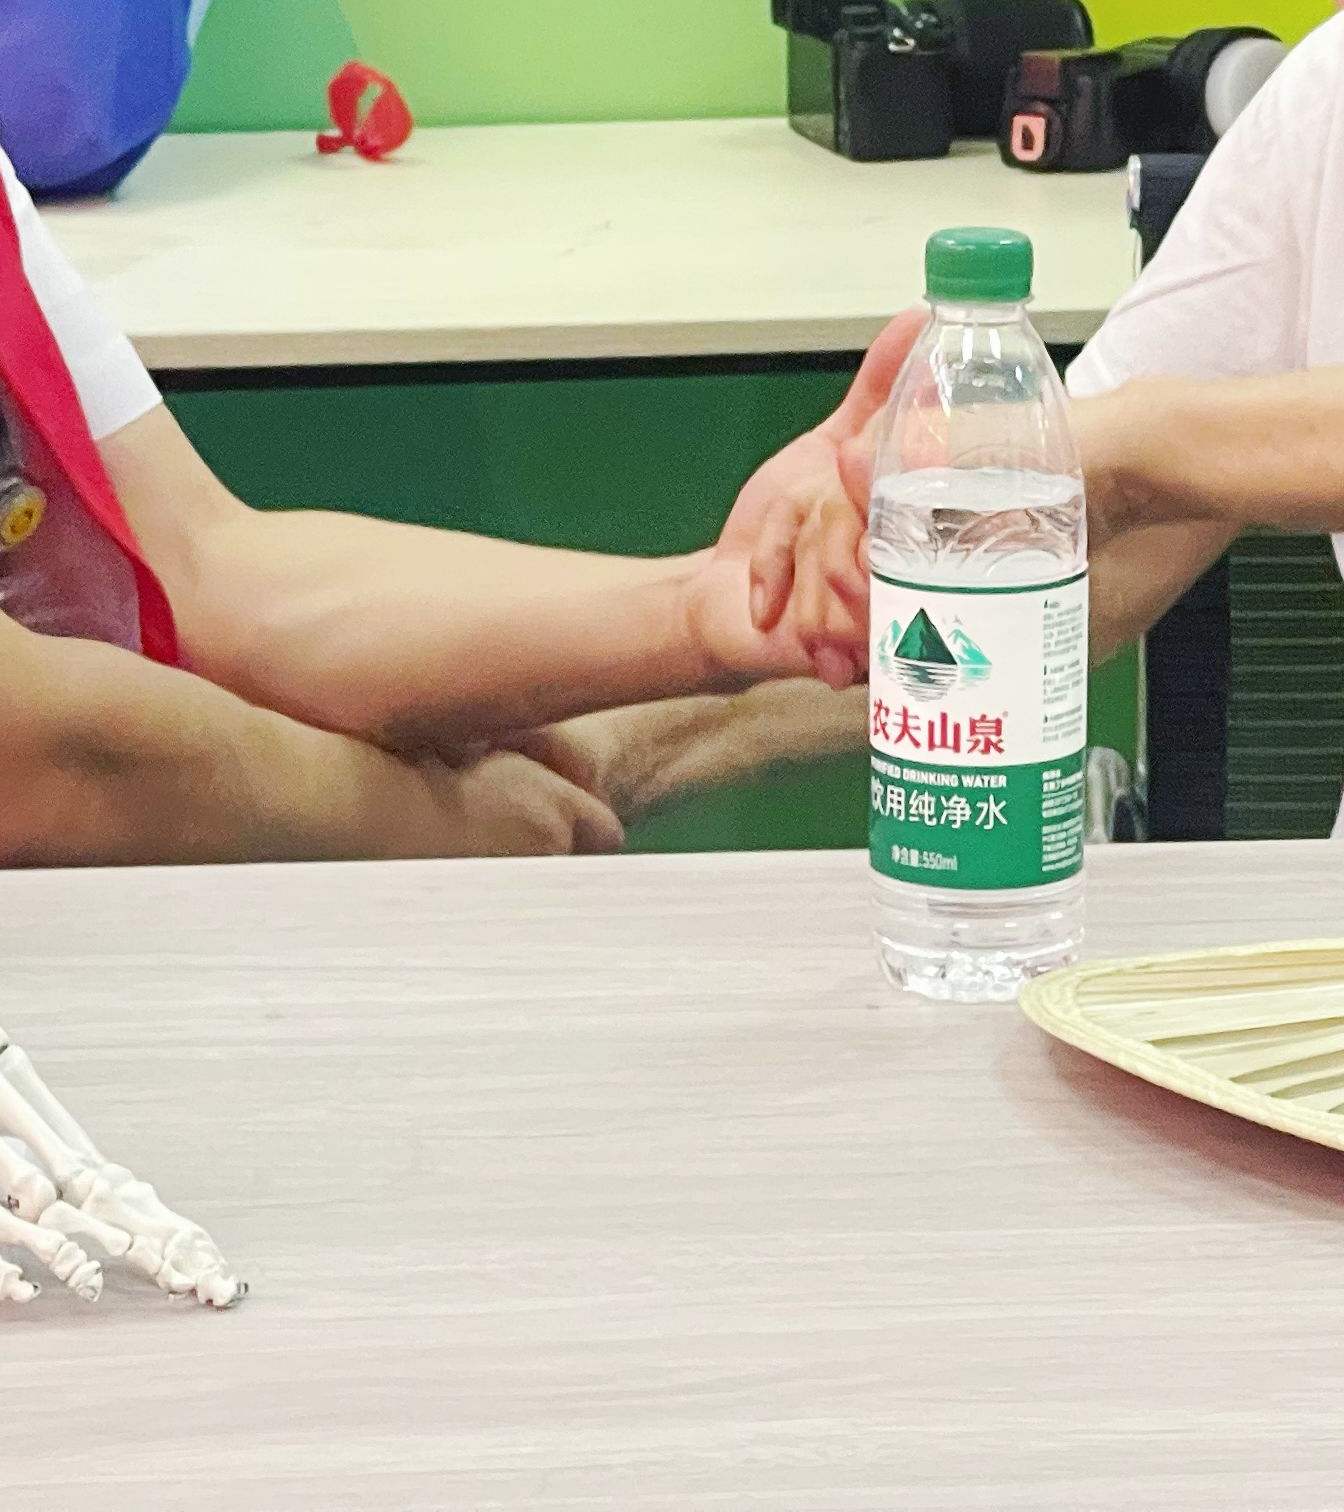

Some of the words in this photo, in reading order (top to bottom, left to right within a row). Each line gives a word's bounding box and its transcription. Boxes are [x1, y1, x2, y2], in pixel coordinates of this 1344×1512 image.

[873, 698, 1005, 755] 农夫山泉
[872, 776, 1007, 830] 饮用纯净水
[902, 768, 958, 788] DRINKING
[962, 774, 1007, 788] WATER
